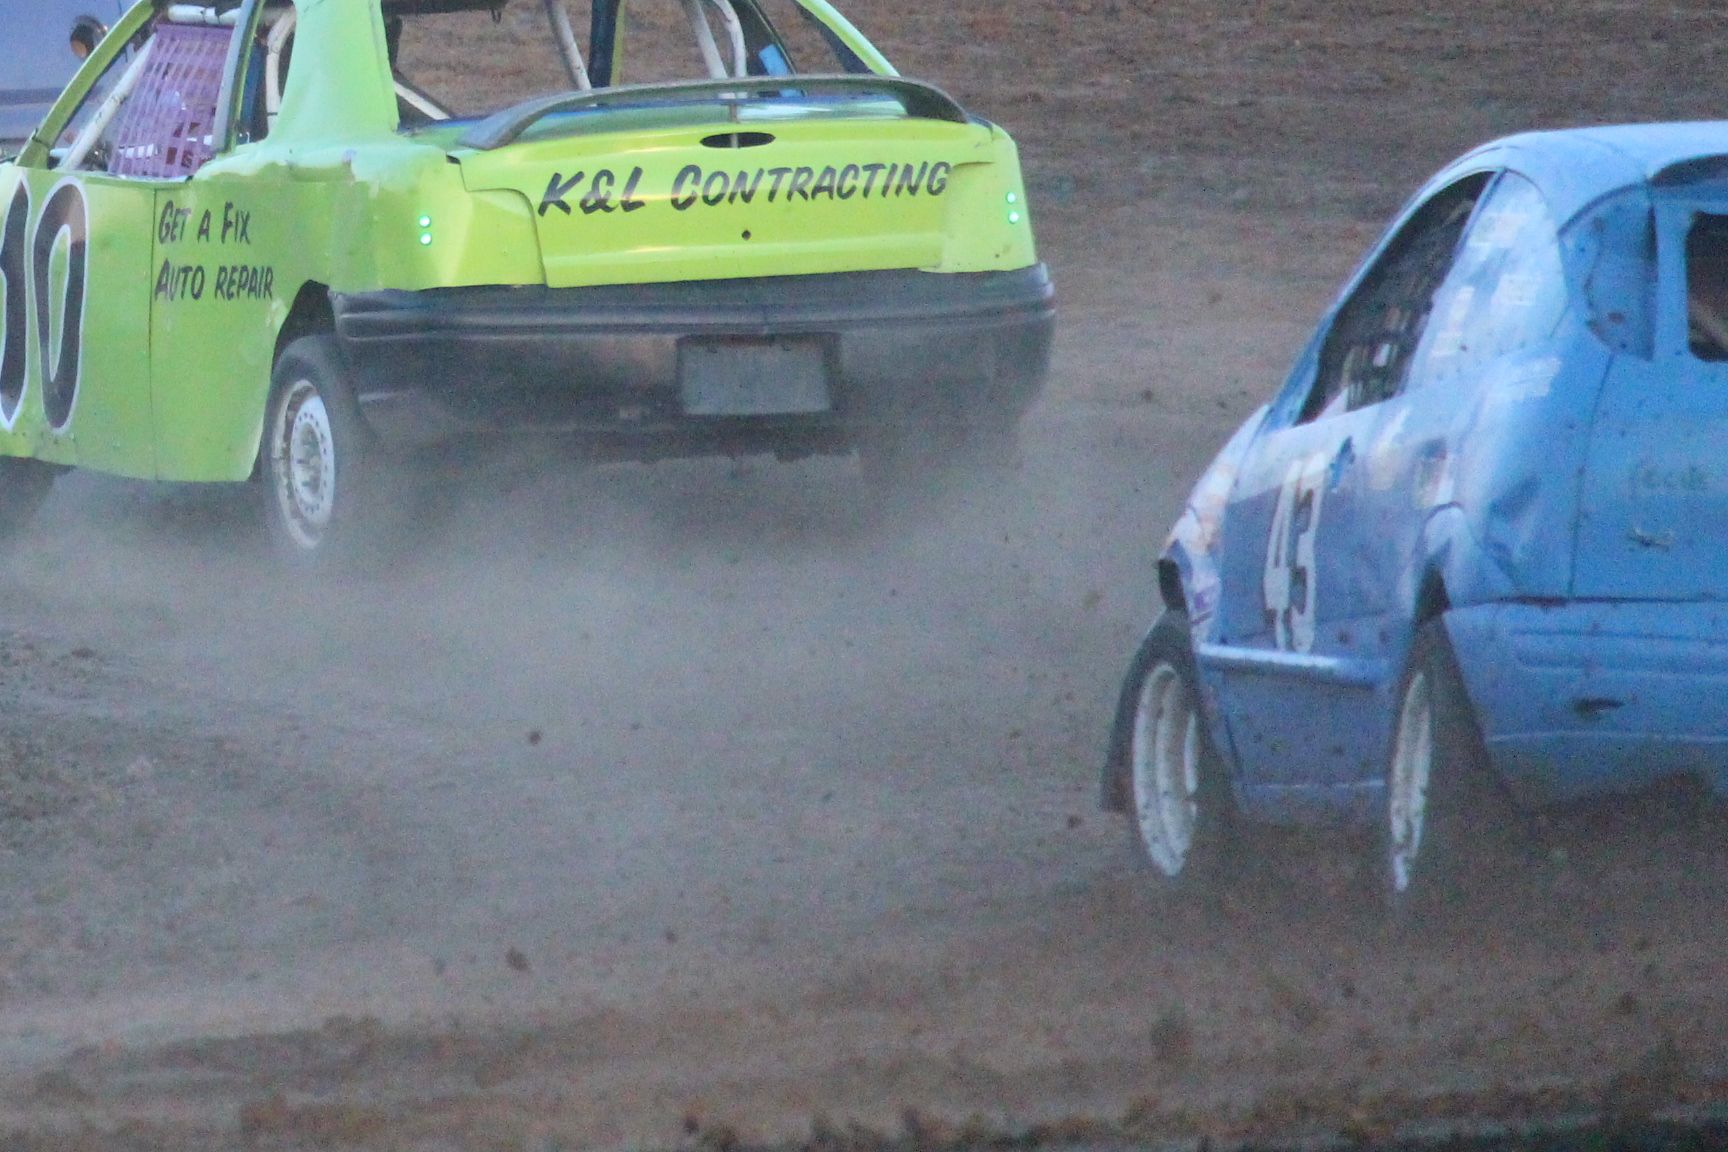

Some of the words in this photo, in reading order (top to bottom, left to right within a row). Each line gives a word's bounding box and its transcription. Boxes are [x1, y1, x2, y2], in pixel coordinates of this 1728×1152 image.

[537, 166, 646, 217] K&L
[671, 161, 952, 211] CONTRACTING
[158, 200, 192, 245] GET
[197, 208, 212, 242] A
[221, 201, 251, 245] FIX
[154, 258, 205, 300] AUTO
[214, 265, 273, 300] REPAIR
